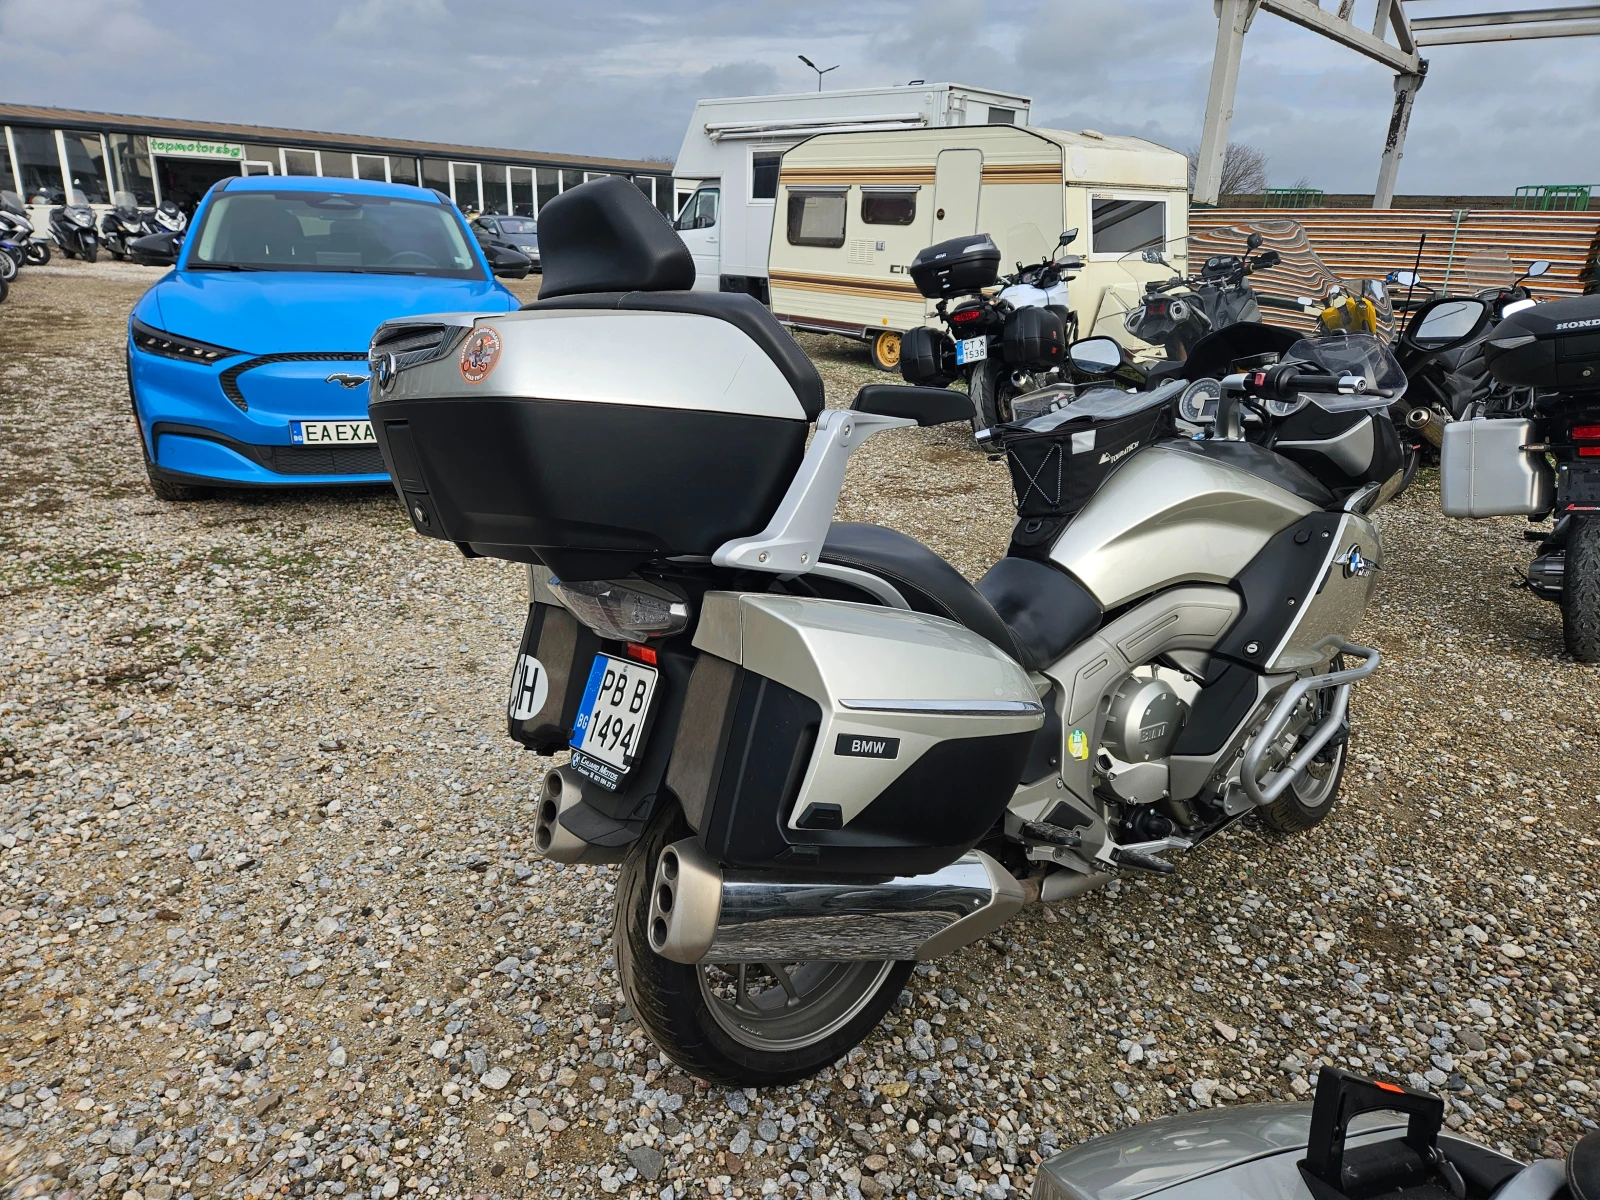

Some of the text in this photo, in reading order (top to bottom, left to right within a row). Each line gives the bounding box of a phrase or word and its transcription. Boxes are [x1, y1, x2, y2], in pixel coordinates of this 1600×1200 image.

[151, 138, 240, 157] topmotorsbg
[964, 341, 975, 350] CT
[965, 348, 985, 359] 1538
[598, 670, 647, 714] PB B
[577, 713, 589, 730] BG
[589, 710, 636, 757] 1494
[851, 739, 886, 754] BMW
